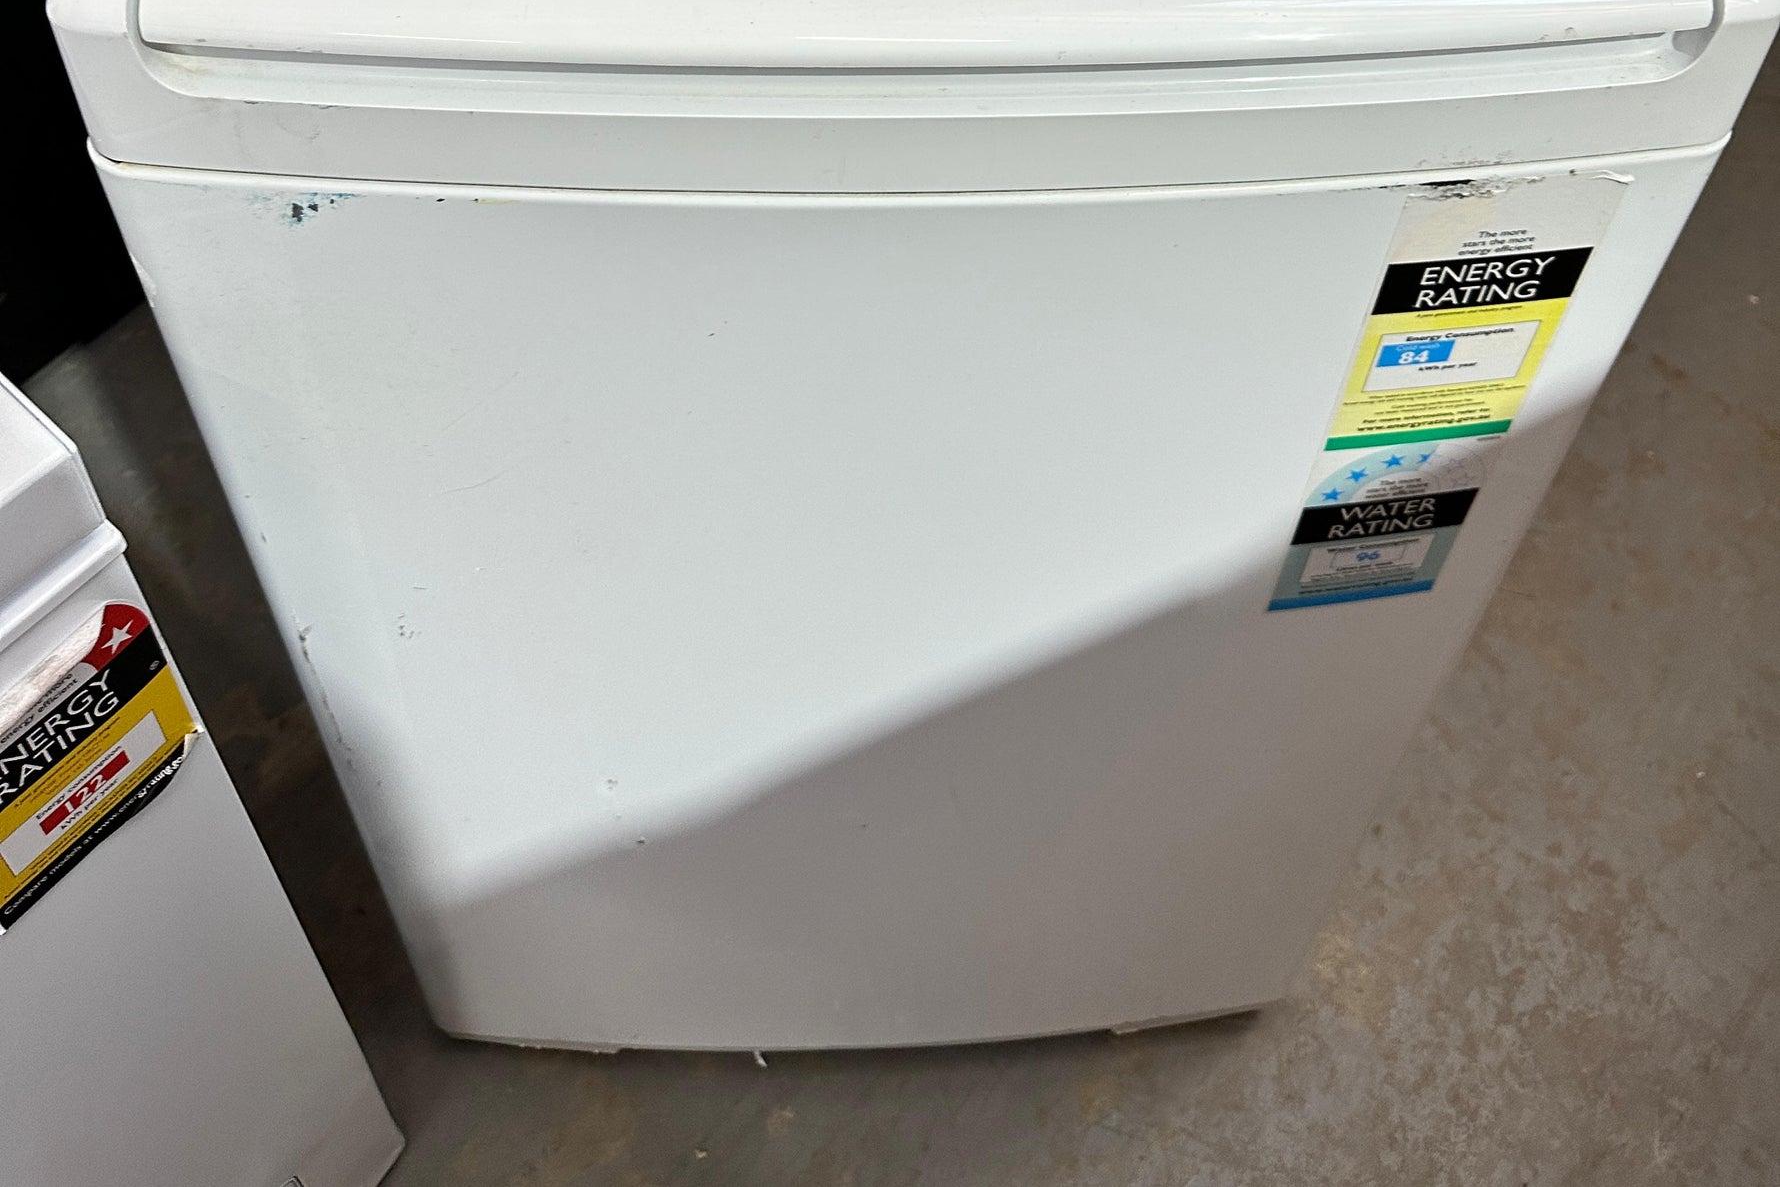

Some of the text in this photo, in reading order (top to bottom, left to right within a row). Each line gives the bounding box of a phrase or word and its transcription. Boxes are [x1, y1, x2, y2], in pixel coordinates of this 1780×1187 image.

[1462, 240, 1486, 248] stars
[1509, 236, 1536, 244] more
[1479, 230, 1498, 238] The
[1458, 243, 1534, 256] energy efficient
[1420, 256, 1556, 286] ENERGY
[1412, 280, 1541, 308] RATING
[1406, 327, 1514, 342] Energy Consumption
[1398, 350, 1430, 365] 84
[1341, 498, 1436, 521] WATER
[1327, 514, 1435, 539] RATING
[1356, 550, 1381, 561] 96
[0, 671, 109, 775] NERGY
[1, 714, 35, 744] energy
[38, 679, 78, 713] efficient
[36, 794, 66, 820] Energy
[68, 746, 122, 793] consumption
[62, 775, 109, 813] 122
[61, 779, 118, 830] kWh per year
[5, 877, 48, 915] Compare
